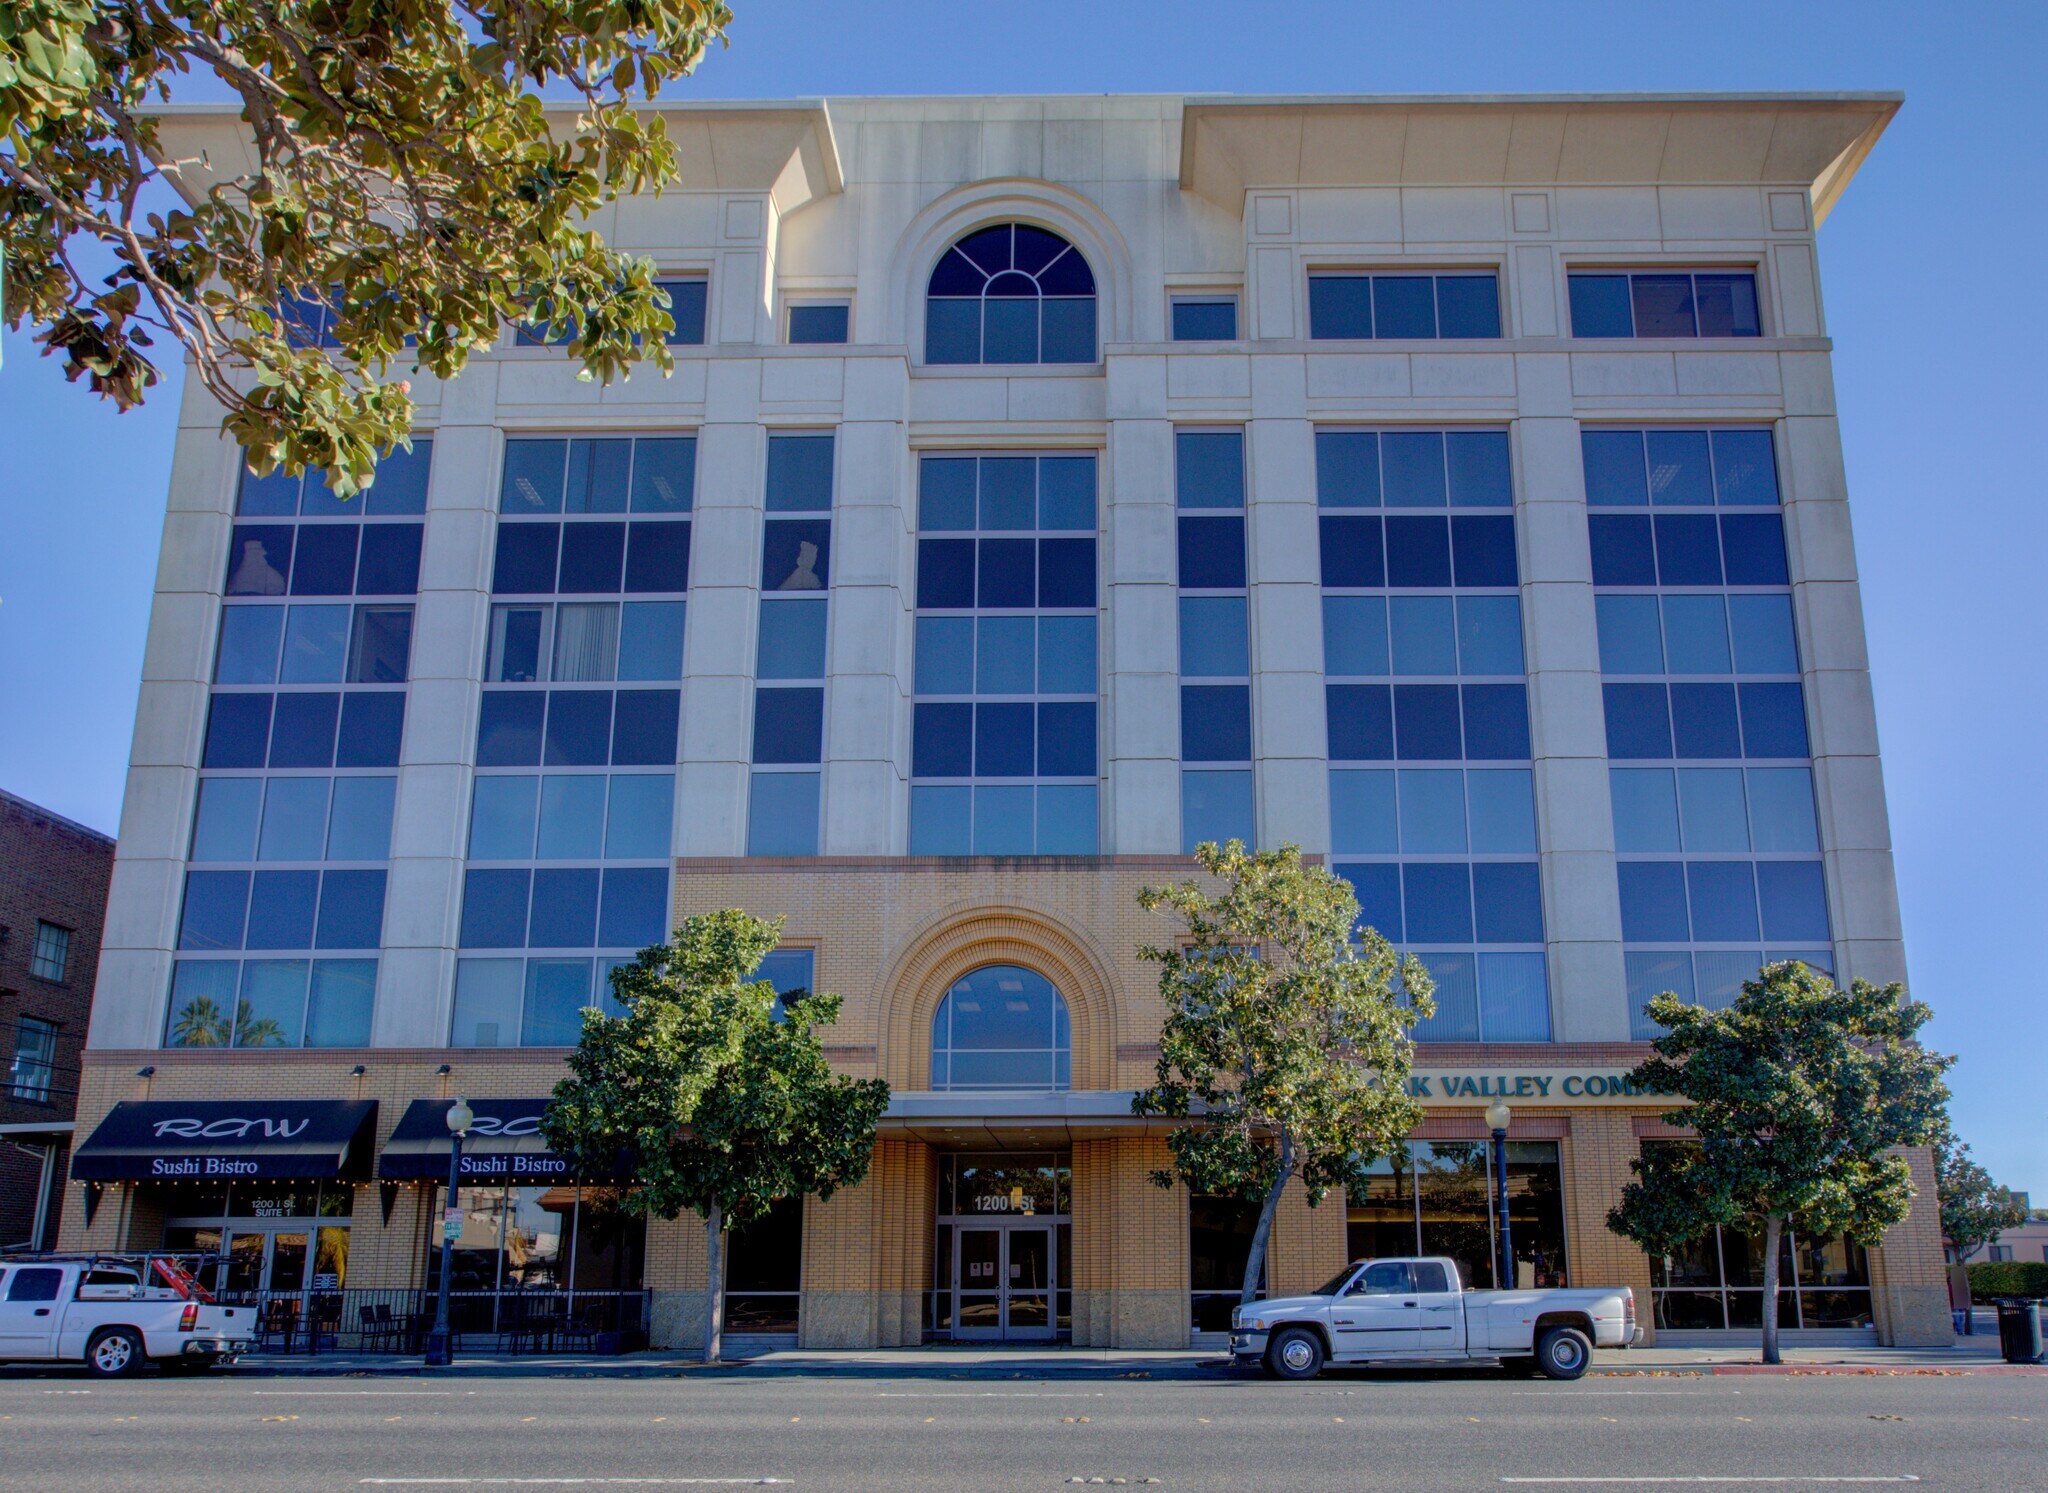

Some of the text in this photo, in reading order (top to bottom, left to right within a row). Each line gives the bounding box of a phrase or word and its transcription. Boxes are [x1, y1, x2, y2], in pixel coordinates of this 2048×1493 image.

[1440, 1076, 1554, 1098] VALLEY
[153, 1117, 310, 1138] RAW
[152, 1158, 258, 1175] Sushi Bistro
[460, 1156, 566, 1174] Sushi Bistro
[251, 1199, 274, 1208] 1200
[974, 1195, 1008, 1211] 1200
[1020, 1196, 1035, 1211] St
[255, 1208, 283, 1217] SUITE
